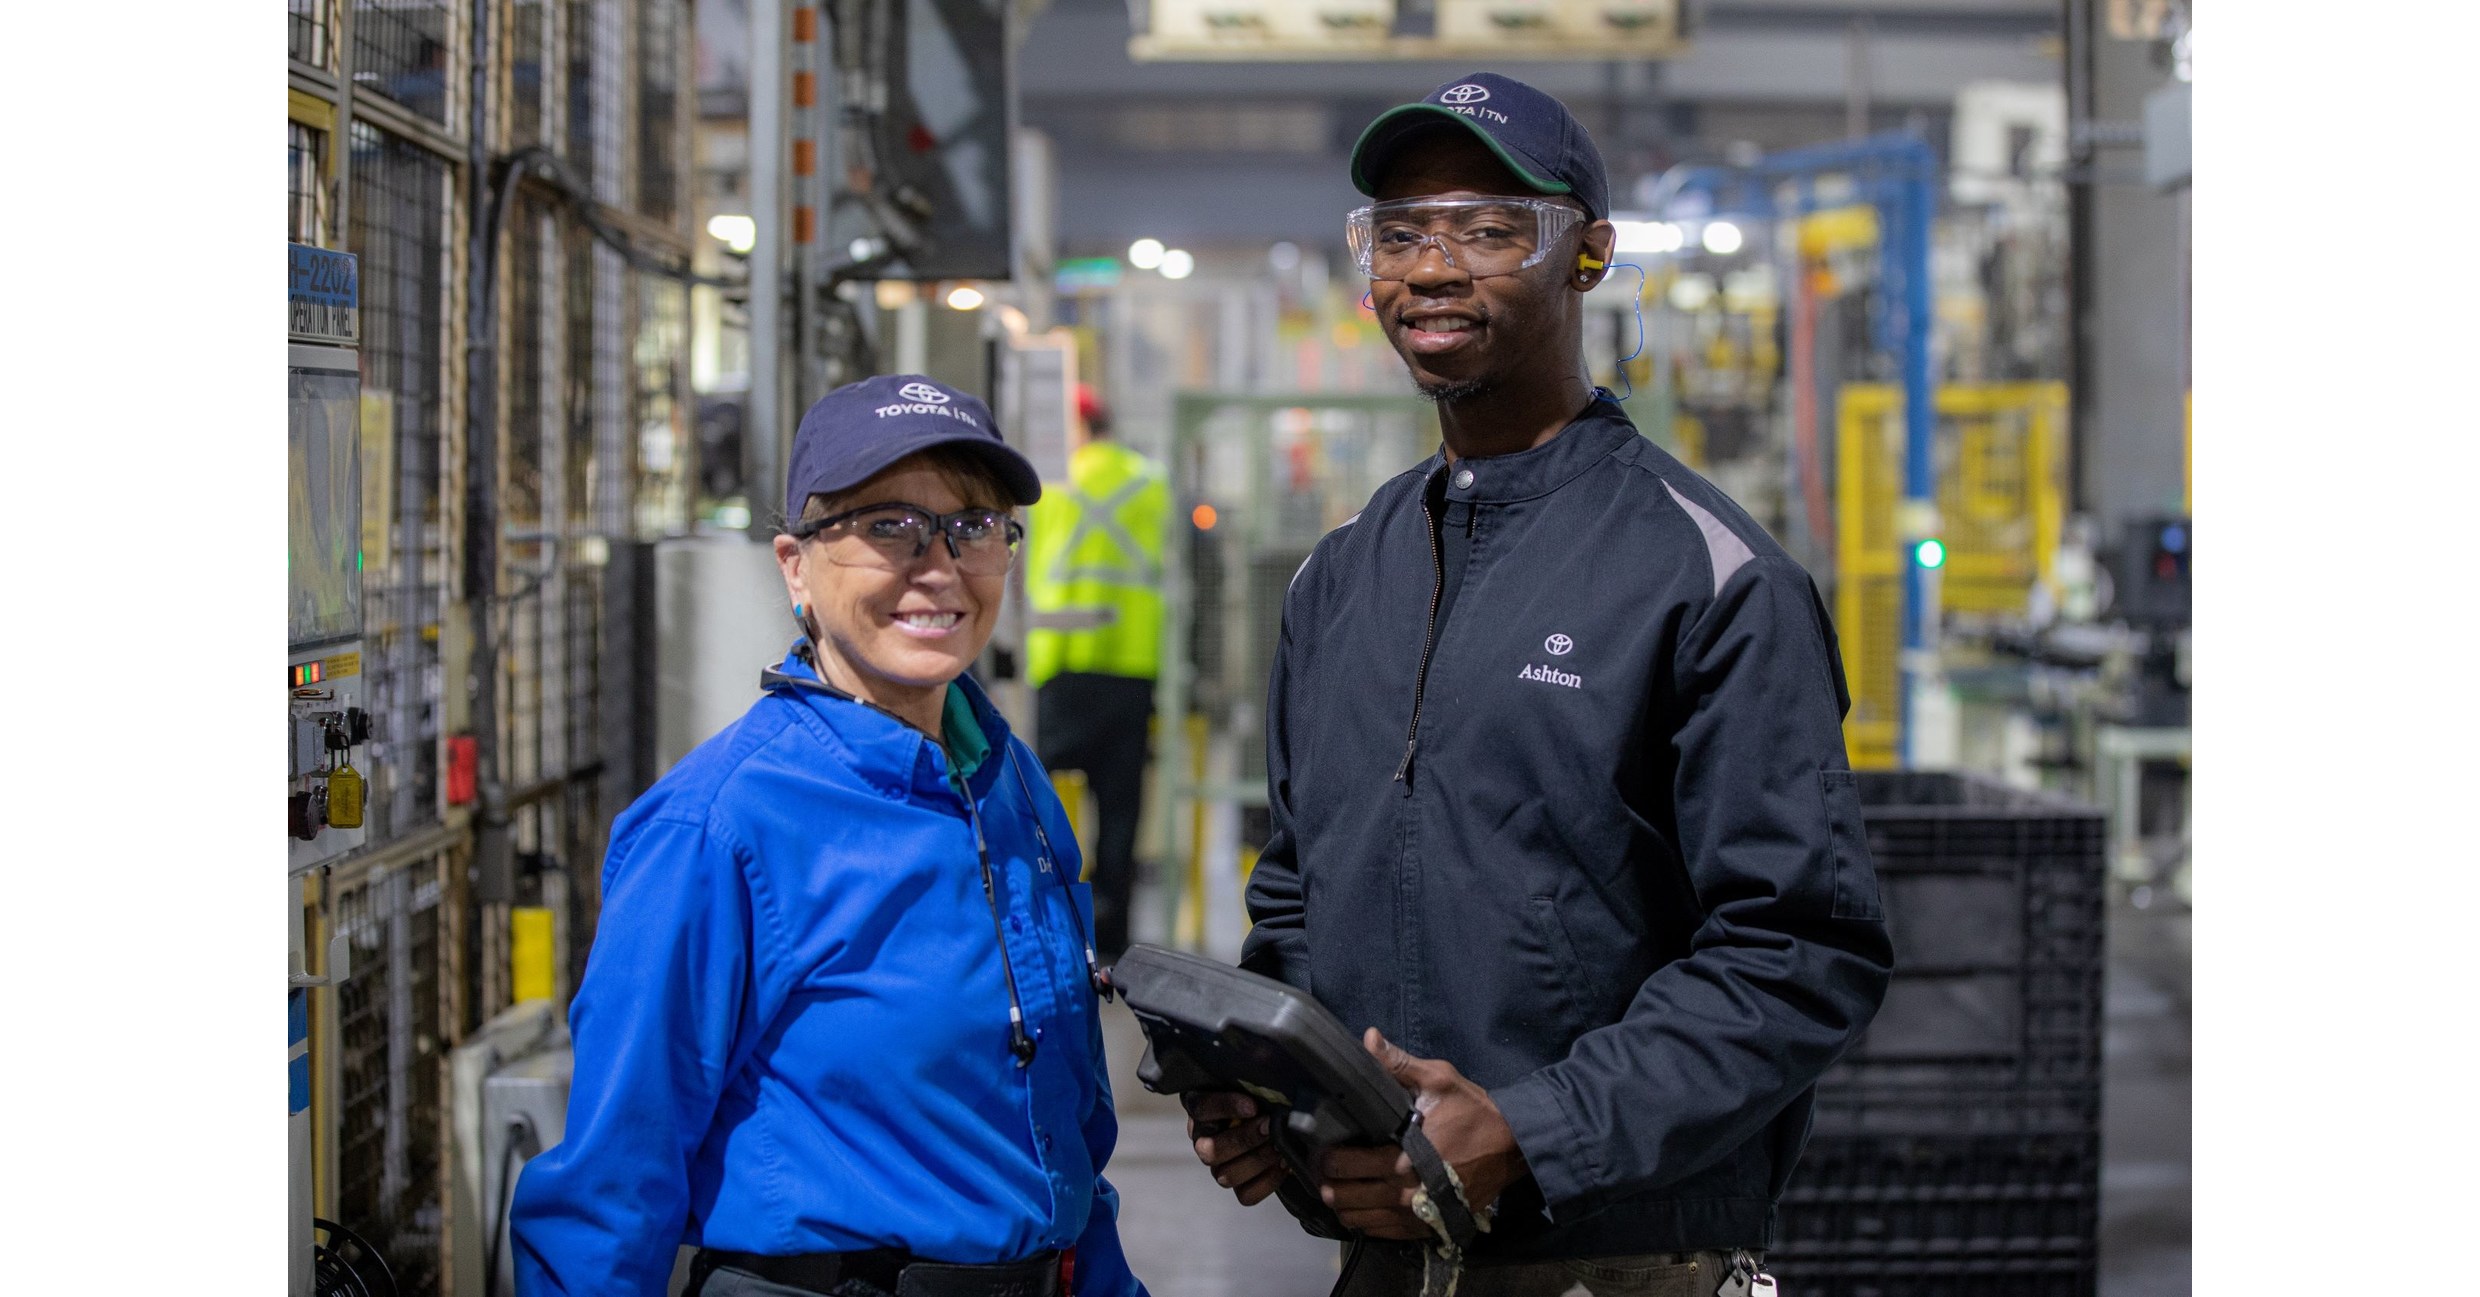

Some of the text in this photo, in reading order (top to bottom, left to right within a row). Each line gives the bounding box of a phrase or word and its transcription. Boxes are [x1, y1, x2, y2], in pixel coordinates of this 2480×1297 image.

[1486, 109, 1508, 124] TN
[291, 293, 352, 337] OPERATION PANEL
[875, 403, 952, 418] TOYOTA
[1518, 664, 1581, 689] Ashton
